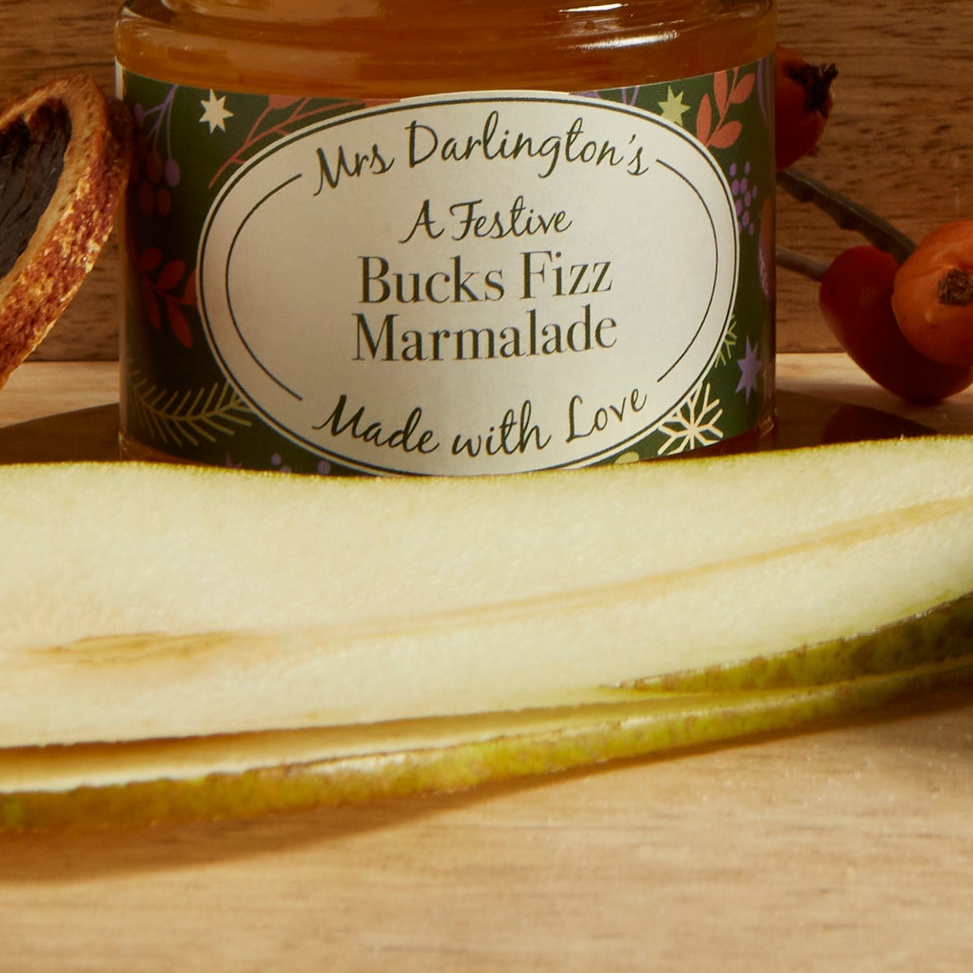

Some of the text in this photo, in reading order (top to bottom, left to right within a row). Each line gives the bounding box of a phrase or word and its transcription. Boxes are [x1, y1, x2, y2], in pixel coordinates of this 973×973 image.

[312, 110, 649, 196] Mrs Darlington's
[398, 195, 573, 243] A Festive
[357, 249, 613, 304] Bucks Fizz
[351, 303, 618, 362] Marmalade
[311, 388, 647, 458] Made with Love
